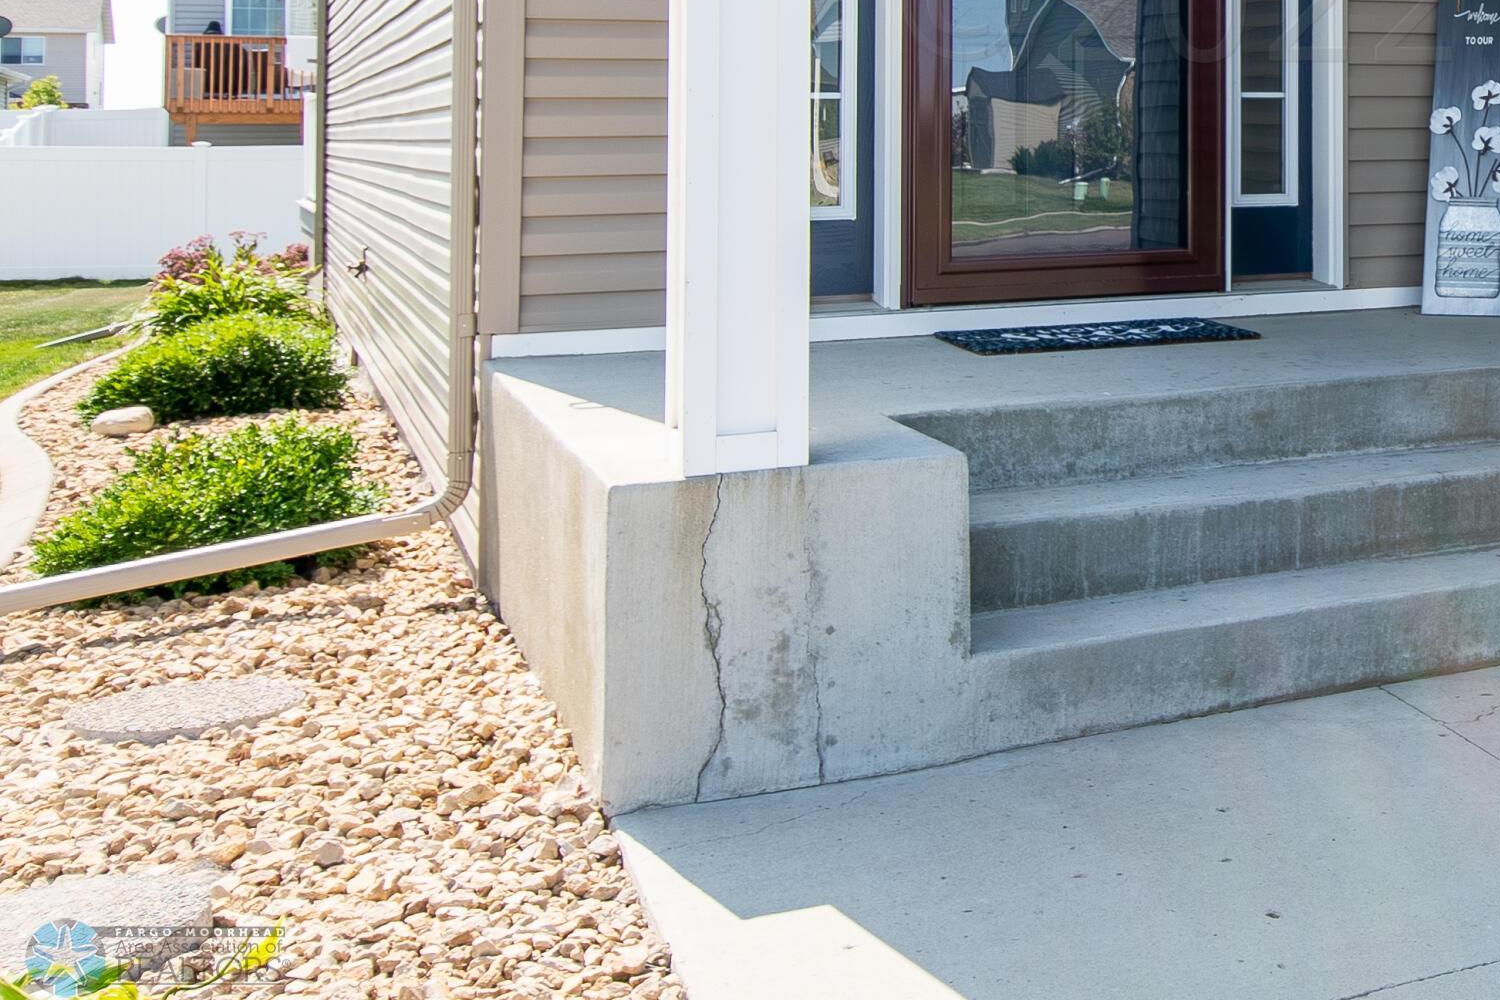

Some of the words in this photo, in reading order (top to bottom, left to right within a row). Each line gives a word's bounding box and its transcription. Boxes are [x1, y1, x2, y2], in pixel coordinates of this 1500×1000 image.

[1465, 36, 1476, 45] TO
[1477, 36, 1493, 45] OUR
[1439, 256, 1499, 279] home
